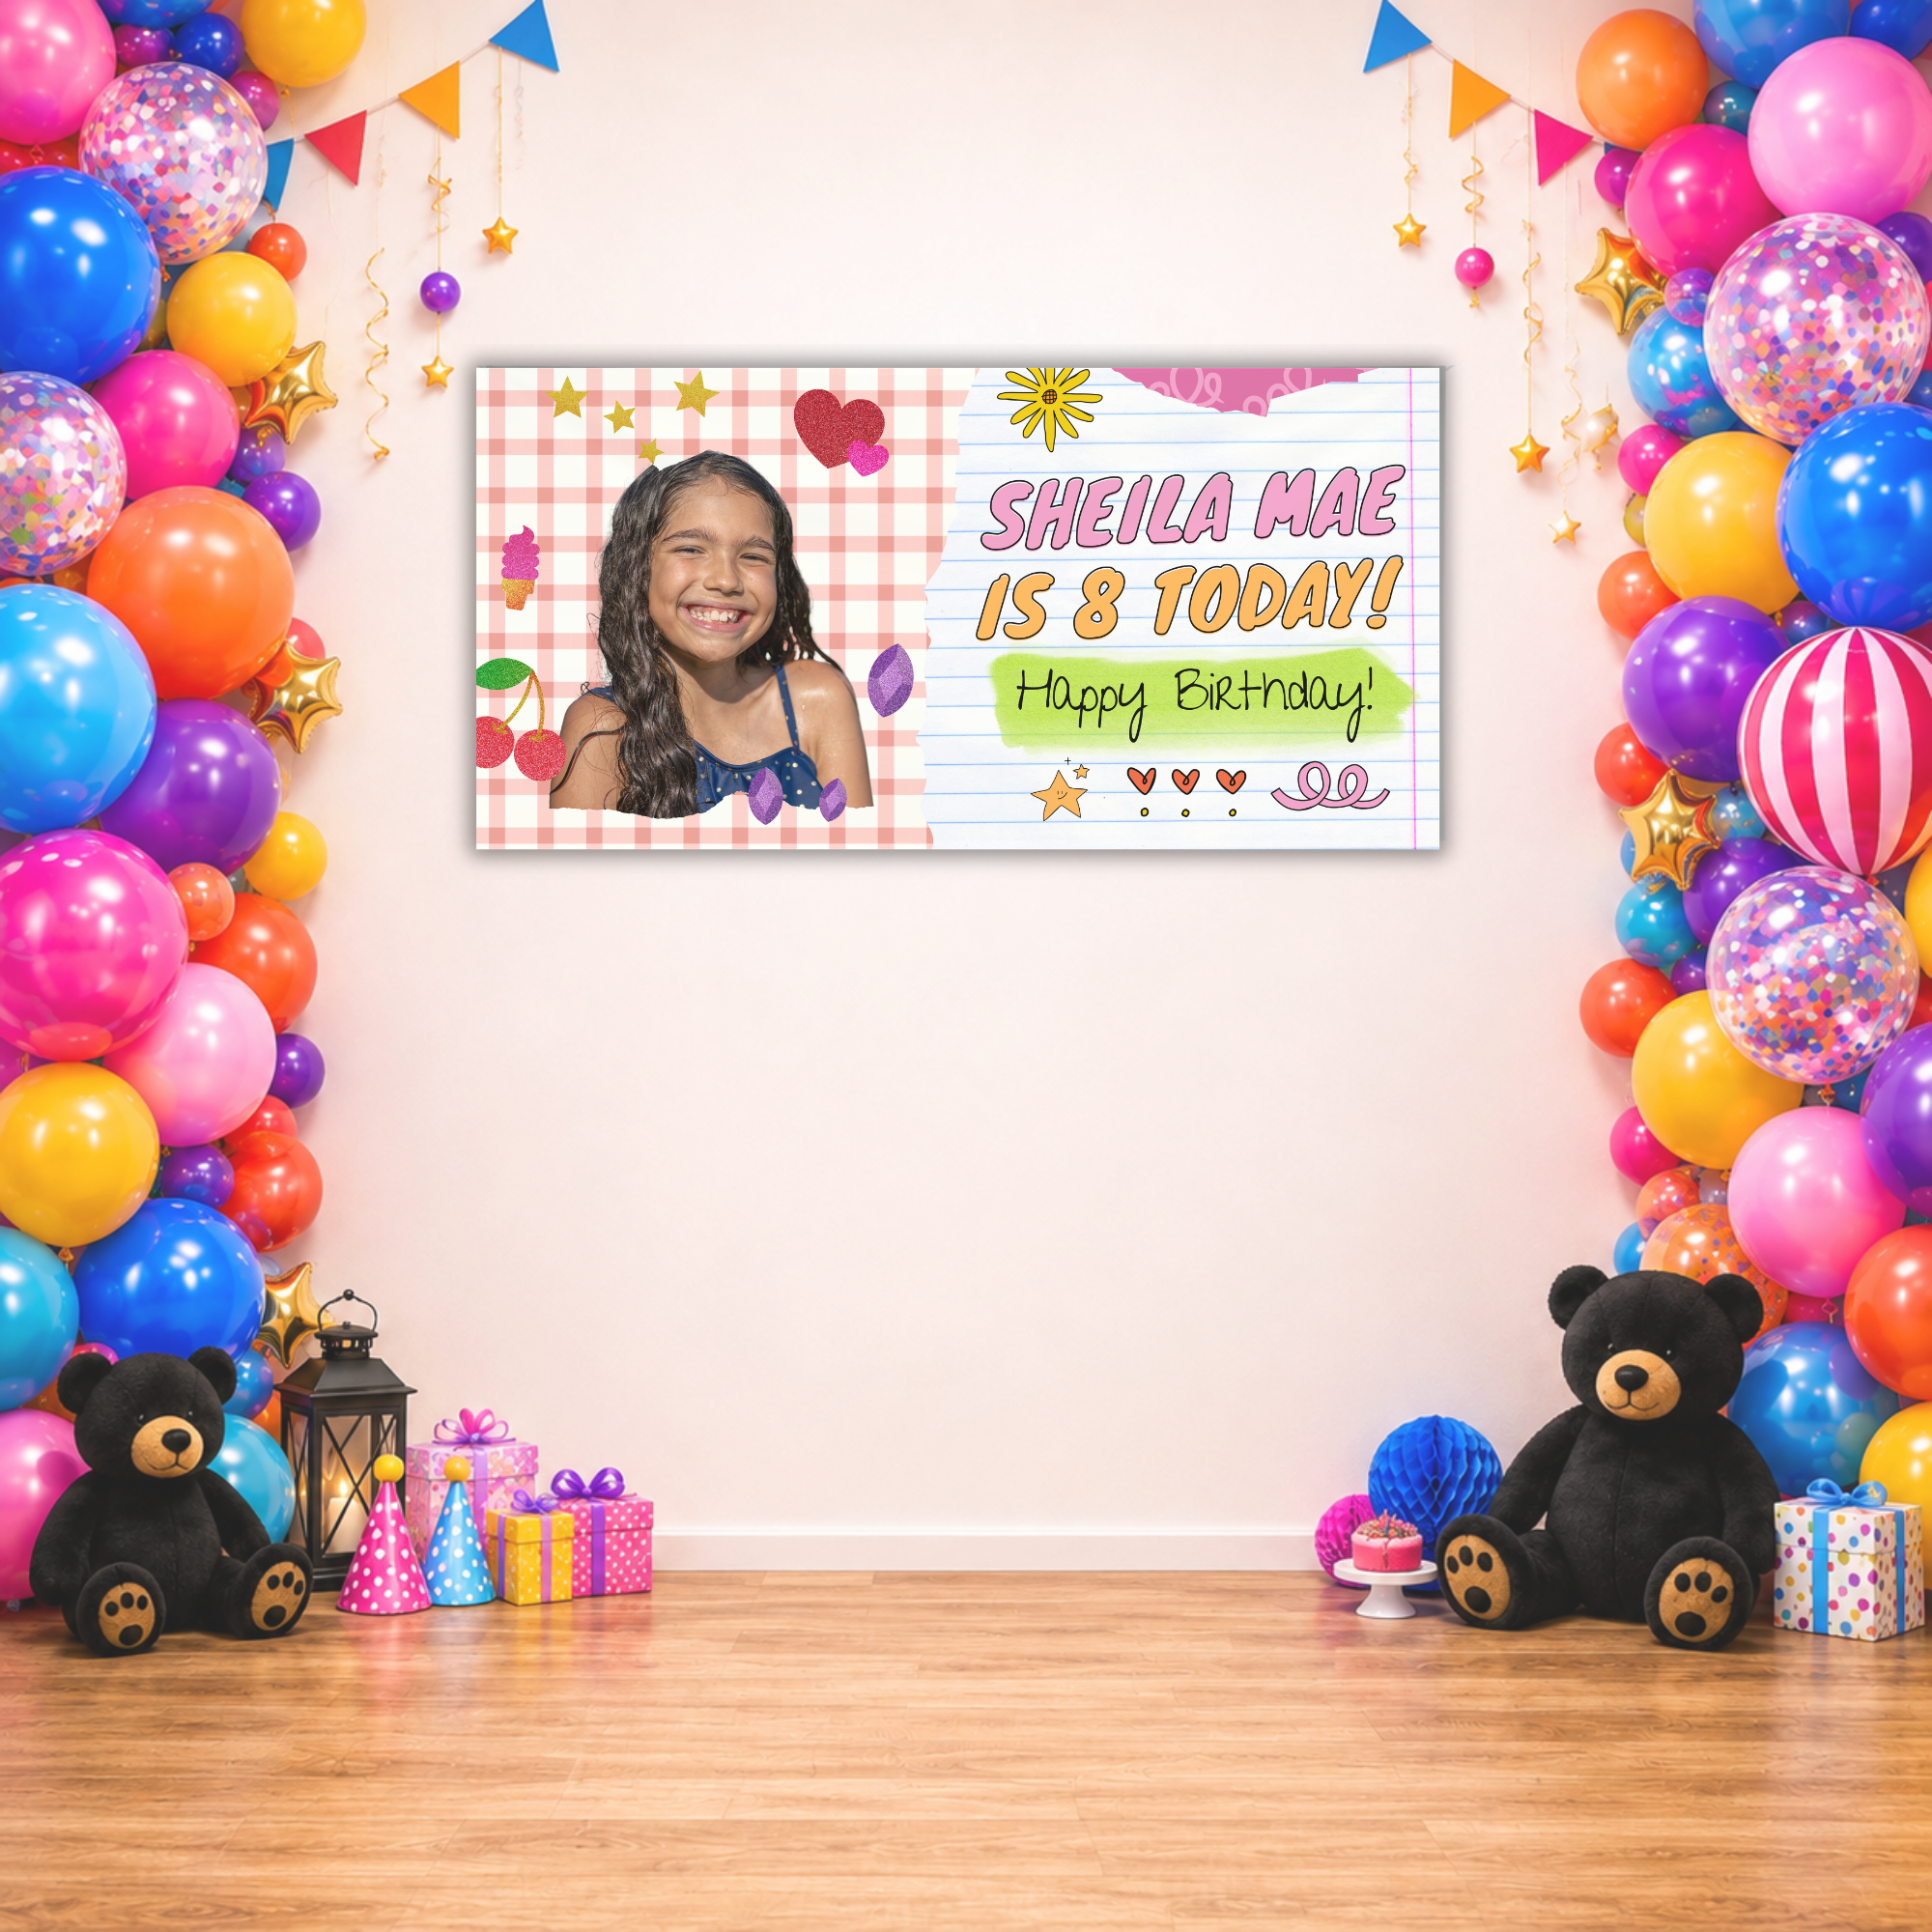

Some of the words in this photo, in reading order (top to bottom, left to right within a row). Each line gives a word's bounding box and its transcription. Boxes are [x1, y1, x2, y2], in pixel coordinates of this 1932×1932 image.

[980, 471, 1233, 551] SHEILA
[1254, 465, 1406, 539] MAE
[976, 572, 1055, 640] IS
[1073, 566, 1125, 639] 8
[1153, 555, 1404, 636] TODAY!
[1016, 668, 1148, 743] Happy
